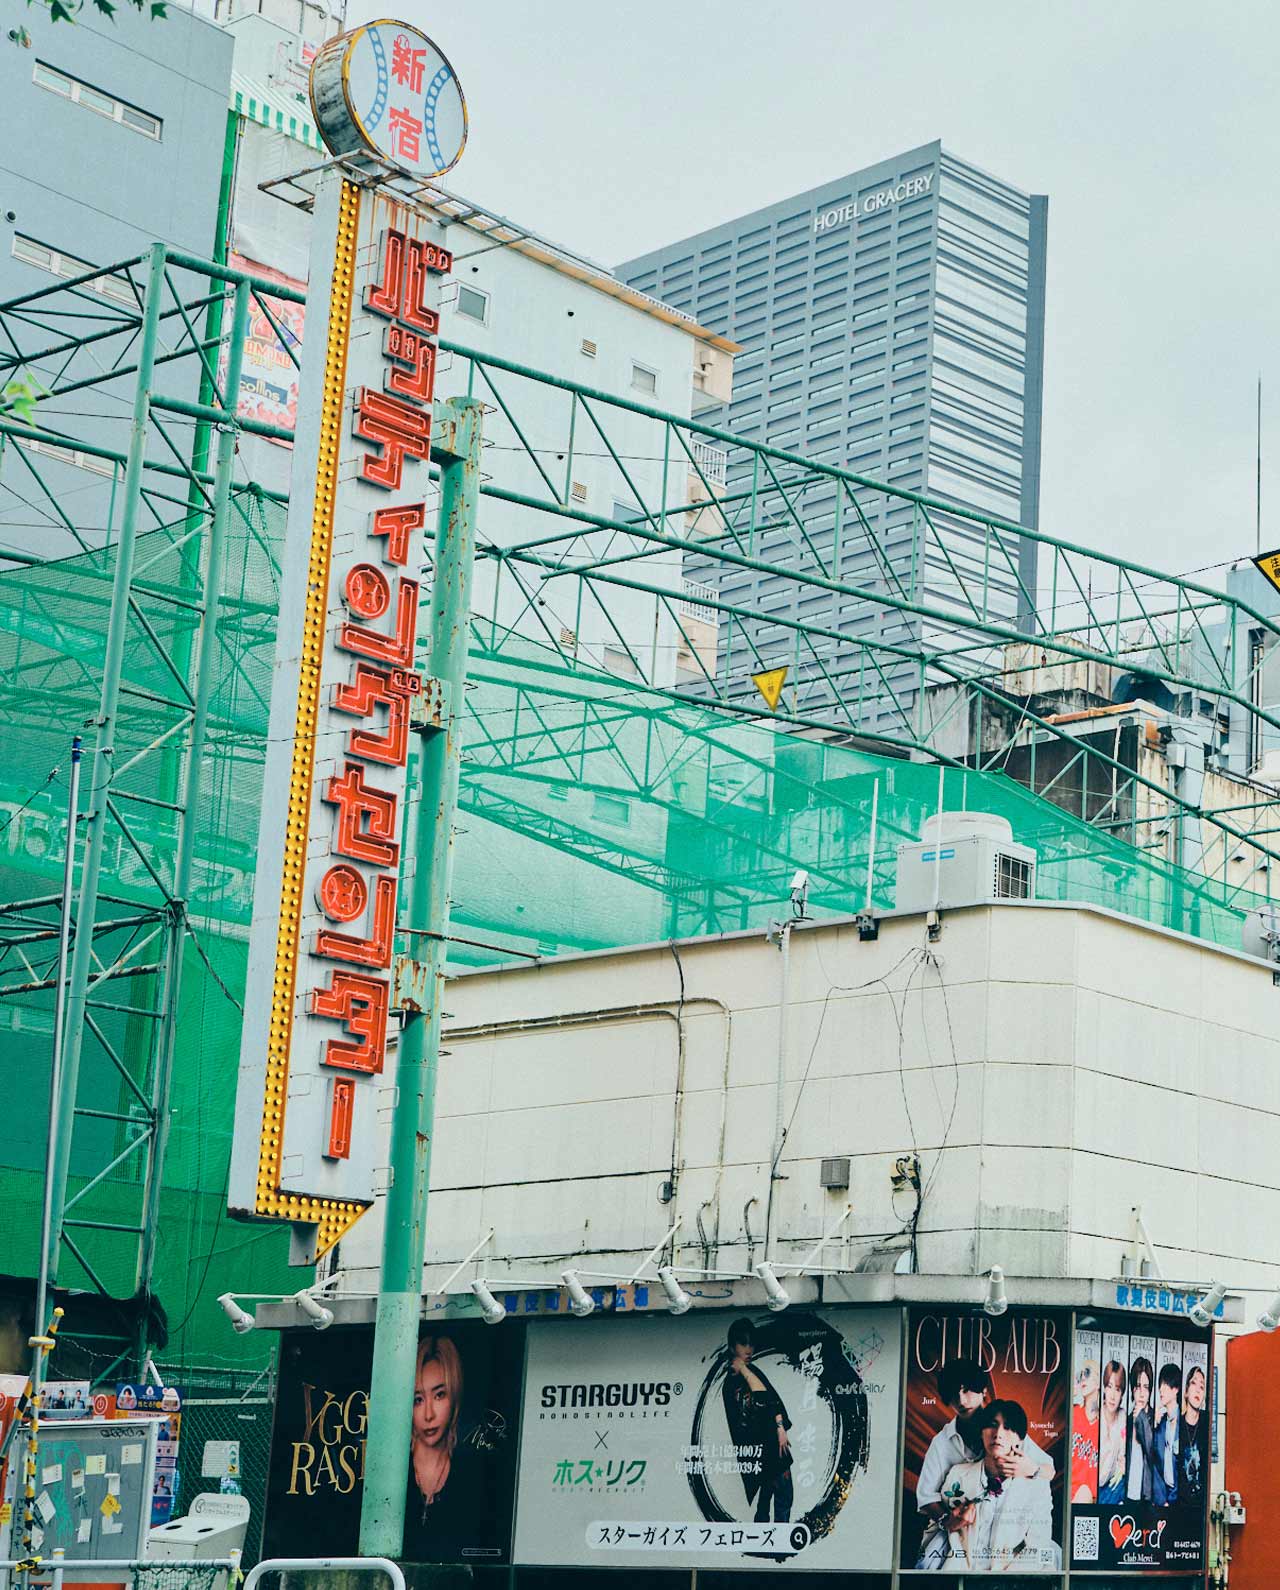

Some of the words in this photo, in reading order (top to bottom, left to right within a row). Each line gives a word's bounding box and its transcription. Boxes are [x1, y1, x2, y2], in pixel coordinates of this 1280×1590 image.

[391, 34, 427, 163] 新宿
[813, 201, 861, 232] HOTEL
[863, 173, 934, 213] GRACERY
[311, 228, 454, 1160] バッティングセンター
[916, 1315, 996, 1373] CLUB
[1002, 1317, 1061, 1374] AUB
[599, 1526, 688, 1546] スターガイズ
[699, 1528, 776, 1546] フェローズ
[1123, 1552, 1137, 1563] Club
